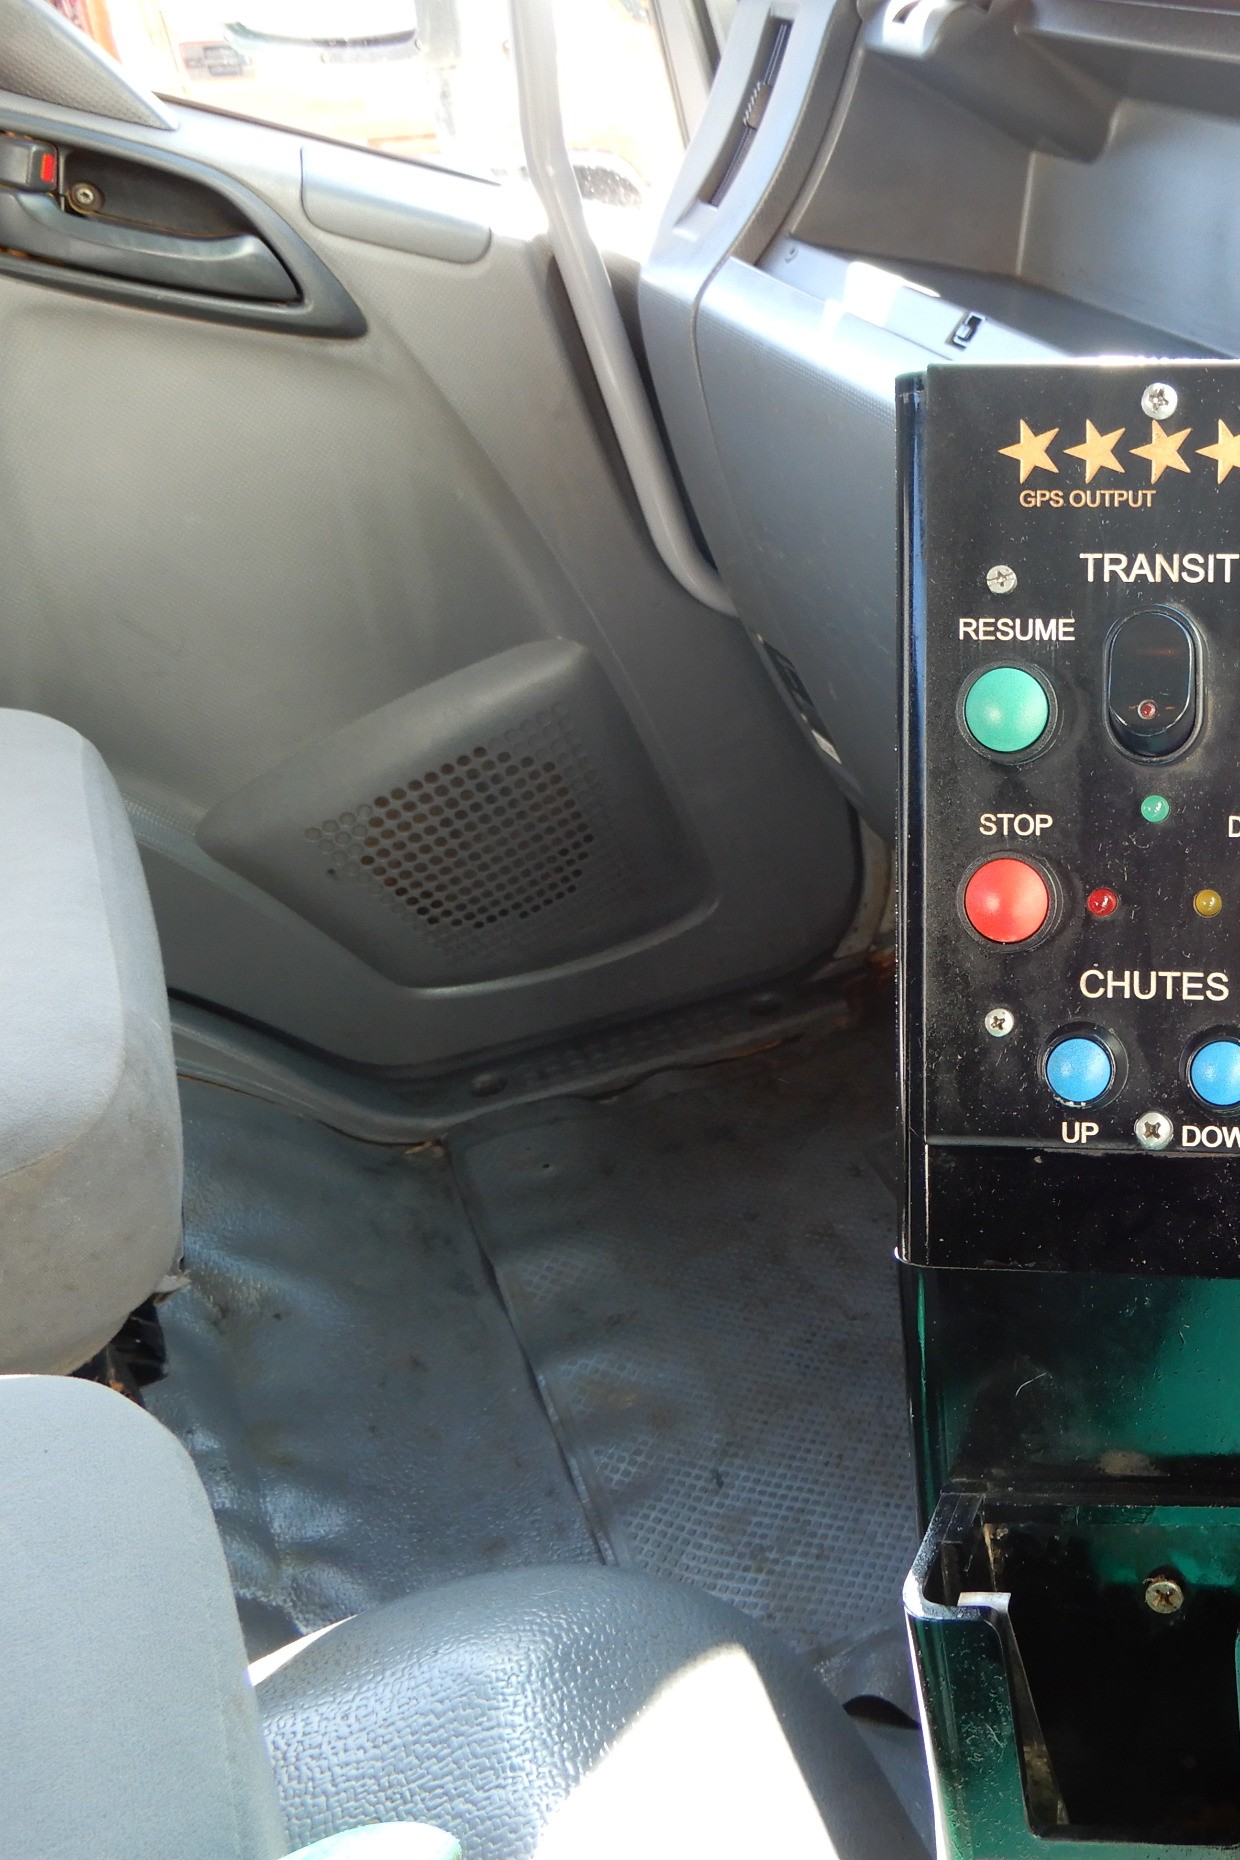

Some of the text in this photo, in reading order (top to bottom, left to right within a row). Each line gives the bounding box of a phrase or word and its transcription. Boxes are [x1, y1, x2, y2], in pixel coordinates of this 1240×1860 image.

[1019, 488, 1157, 508] GPS OUTPUT
[1078, 552, 1240, 584] TRANSIT
[958, 617, 1076, 642] RESUME
[978, 813, 1054, 837] STOP
[1079, 969, 1230, 1002] CHUTES
[1061, 1121, 1100, 1144] UP
